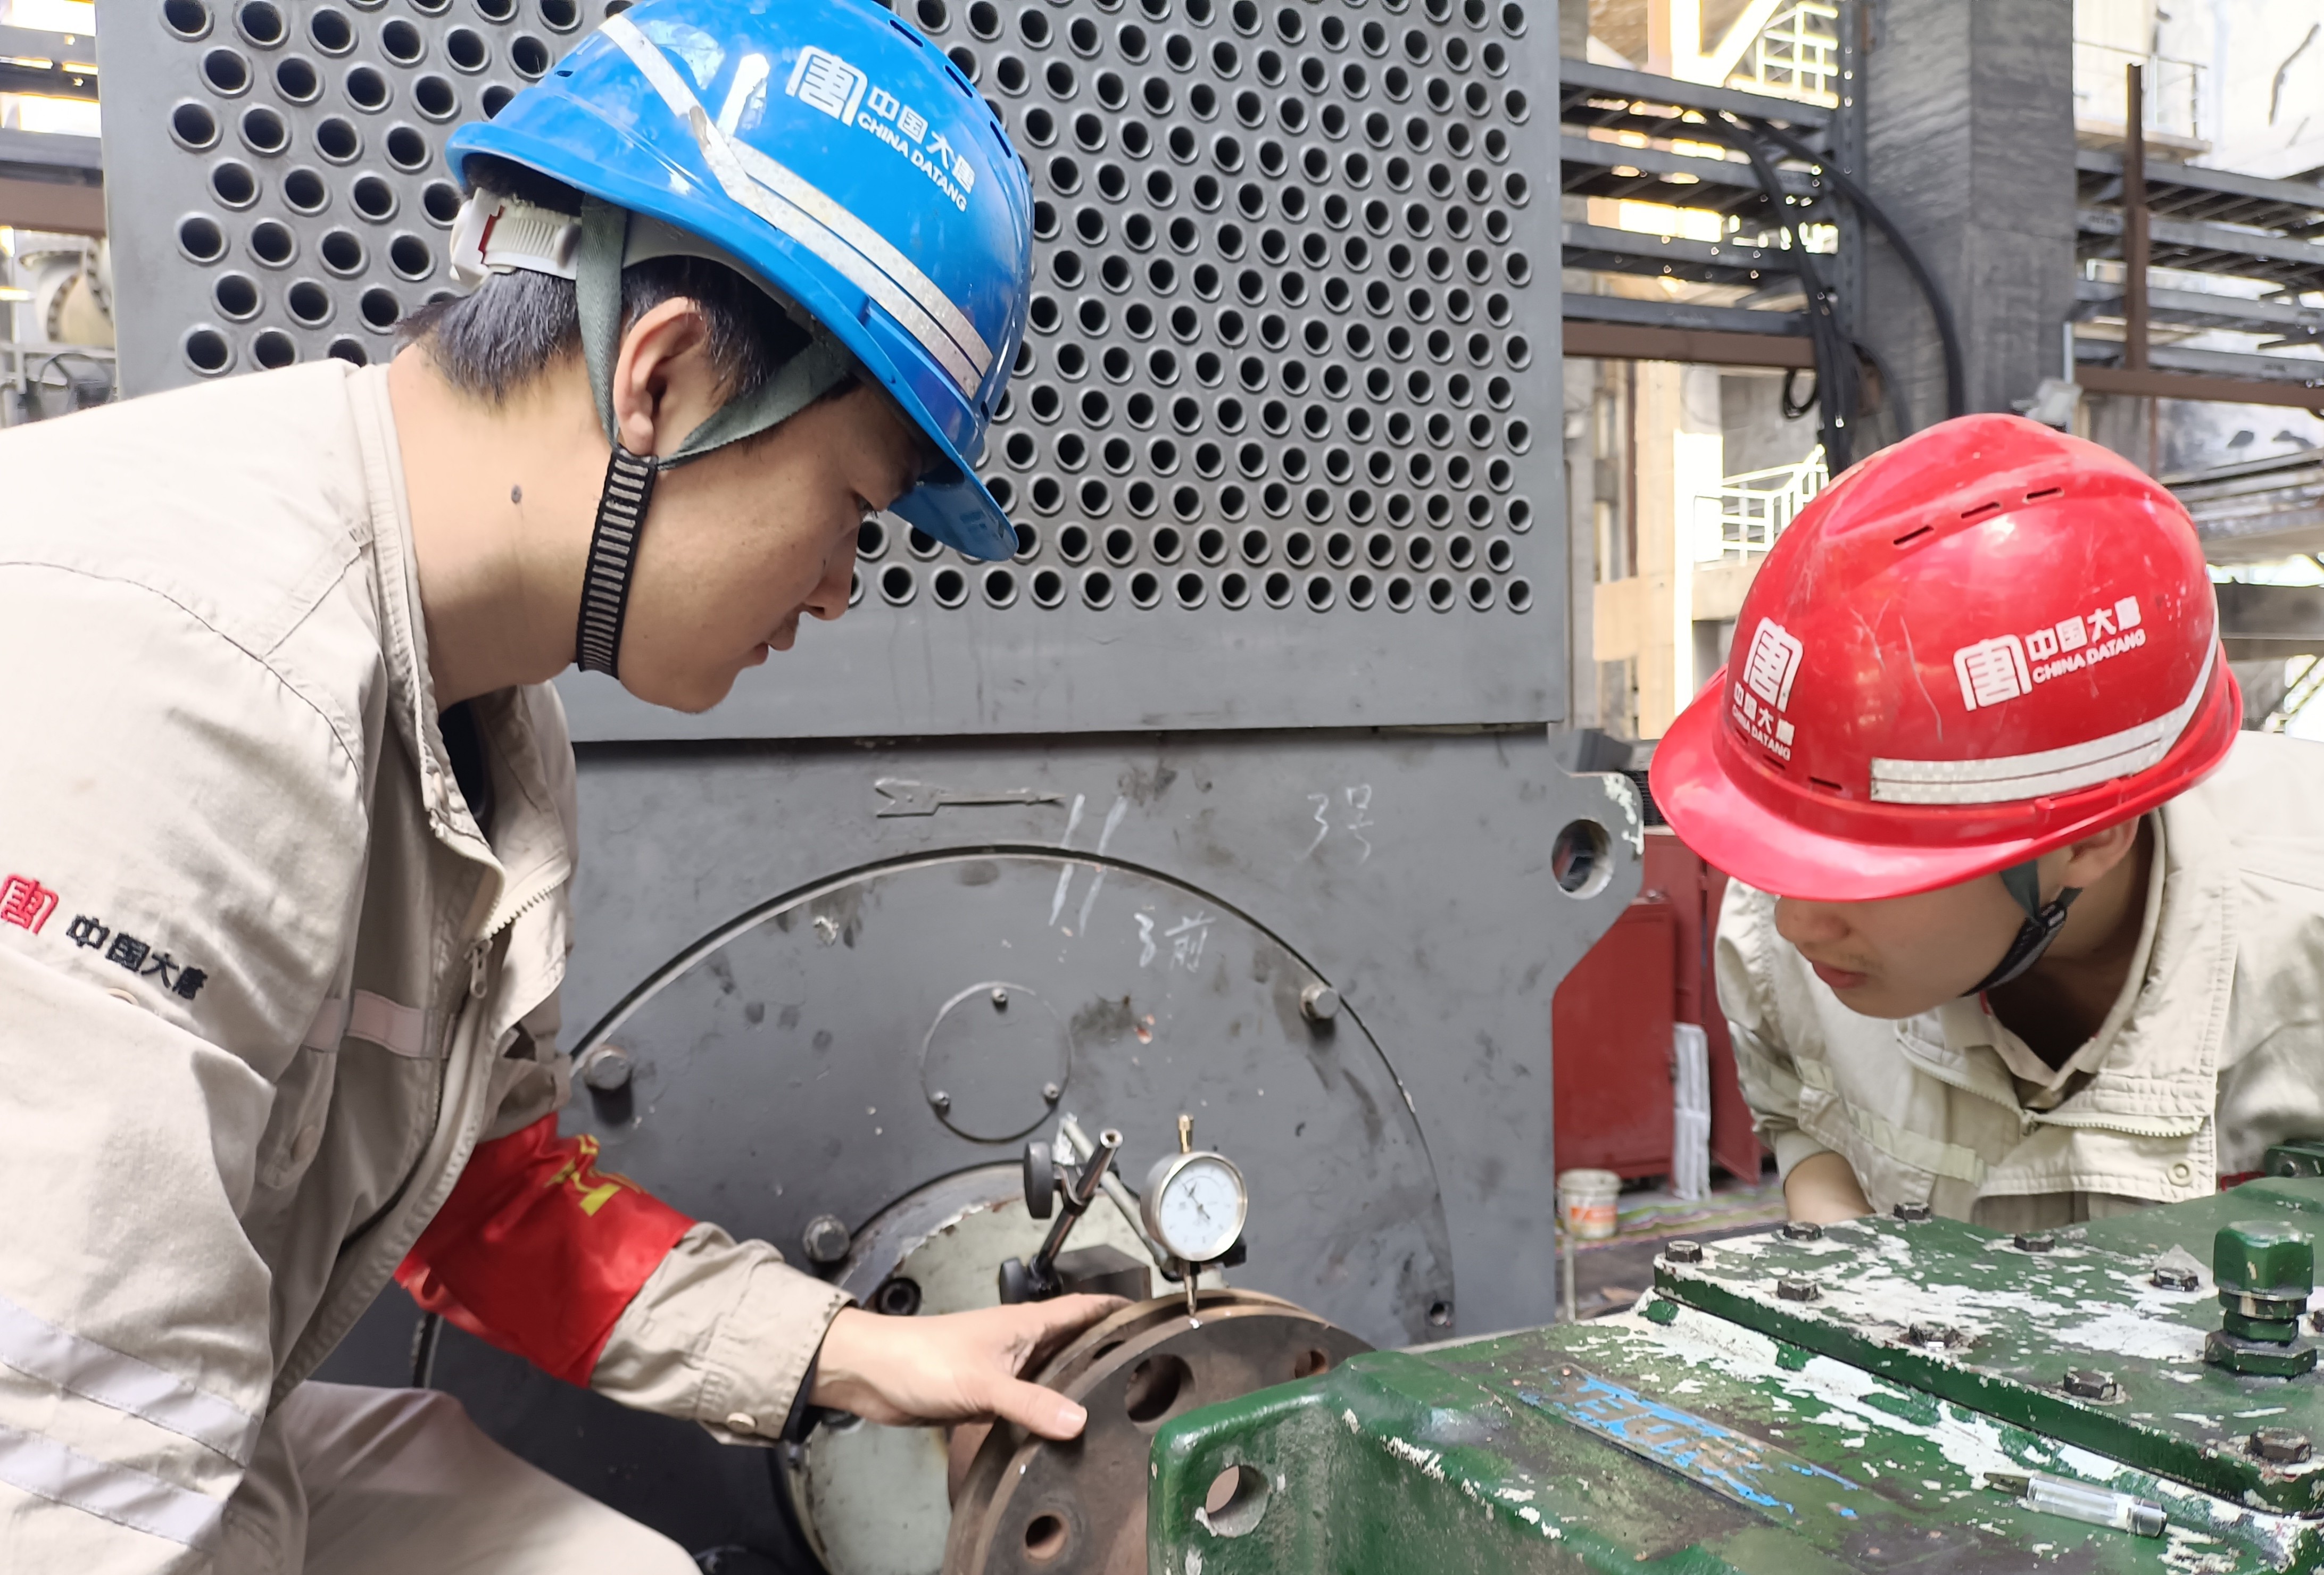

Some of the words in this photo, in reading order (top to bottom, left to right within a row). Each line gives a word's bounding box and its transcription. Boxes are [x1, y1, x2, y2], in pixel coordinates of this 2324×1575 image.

[857, 112, 909, 158] CHINA
[910, 149, 967, 212] DATANG
[2032, 653, 2086, 684] CHINA
[2086, 628, 2146, 664] DATANG
[1733, 680, 1795, 746] 中国大
[1751, 724, 1791, 762] DATANG
